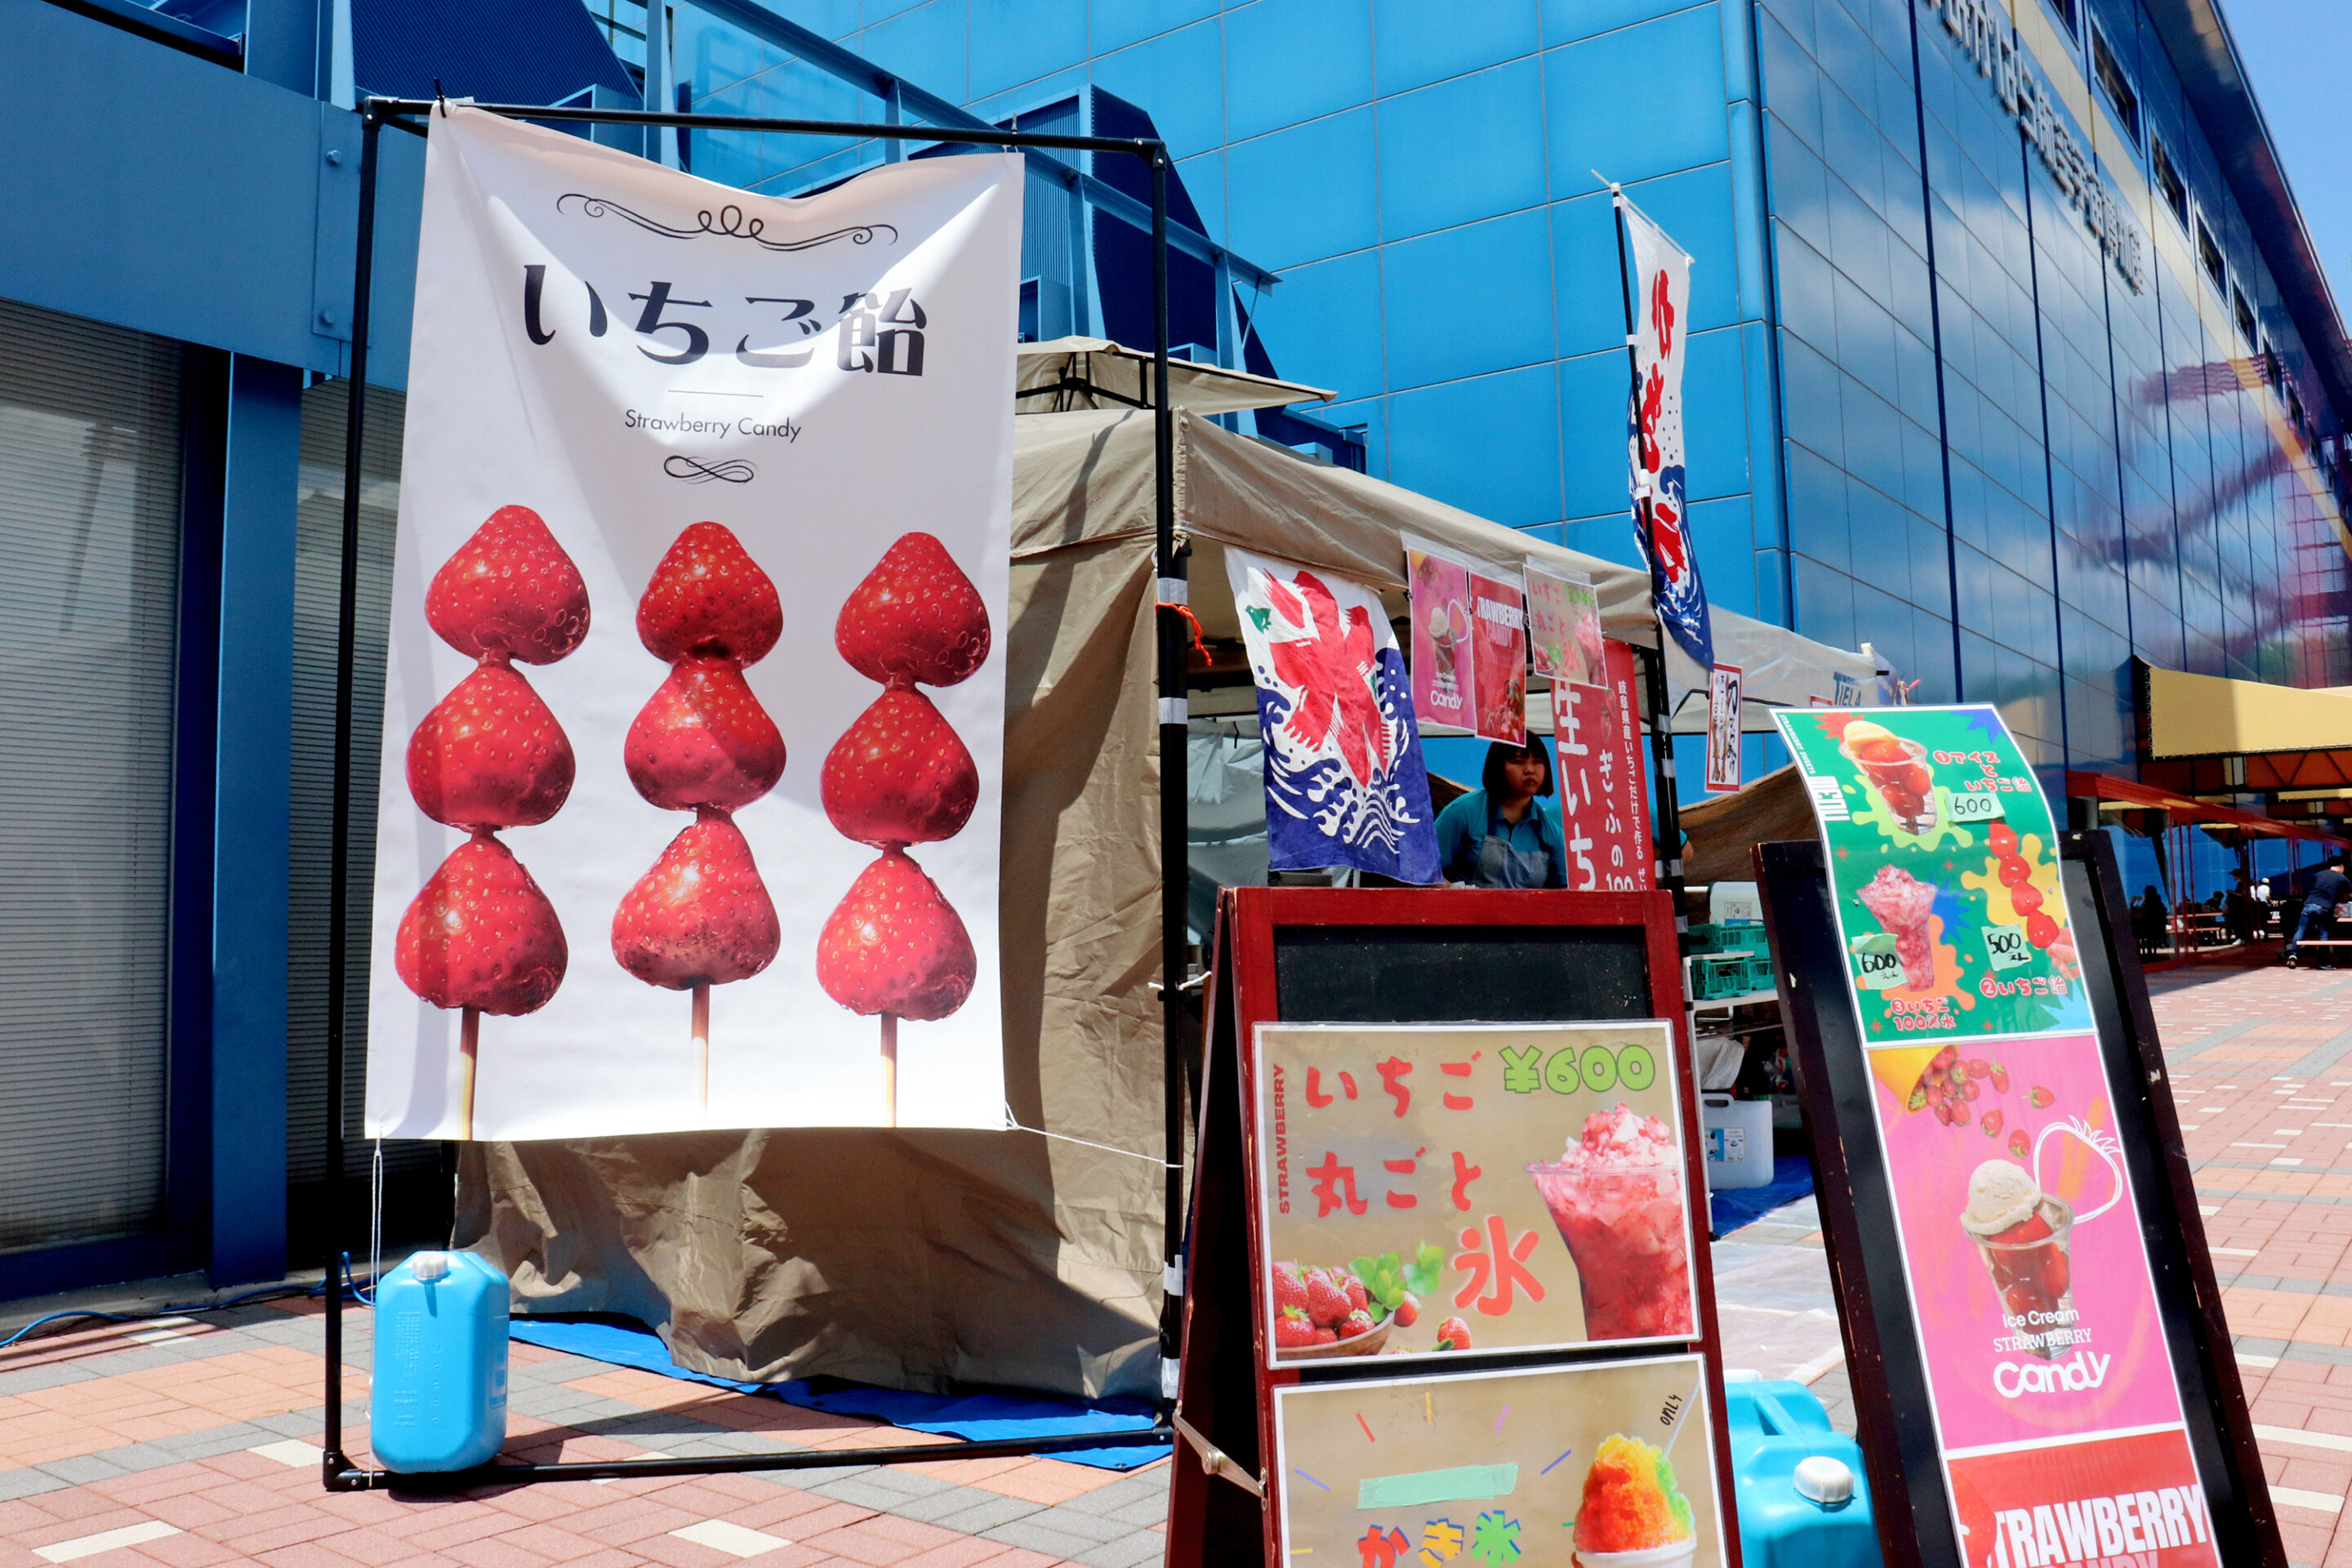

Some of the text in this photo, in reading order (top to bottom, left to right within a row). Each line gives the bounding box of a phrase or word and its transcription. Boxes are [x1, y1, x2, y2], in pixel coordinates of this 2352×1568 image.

[523, 264, 928, 377] いちご飴
[625, 409, 802, 443] Strawberry Candy
[1475, 595, 1525, 631] TRAWBERRY
[1430, 689, 1463, 710] Candy
[1980, 764, 1999, 777] と
[1954, 796, 1992, 815] 600
[1987, 933, 2021, 954] 500
[1862, 952, 1896, 973] 600
[1306, 1045, 1656, 1118] いちご ¥600
[1272, 1062, 1290, 1215] STRAWBERRY
[1306, 1146, 1482, 1218] 丸ごと
[1454, 1214, 1545, 1316] 氷
[2002, 1308, 2080, 1329] Ice Cream
[1993, 1328, 2091, 1353] STRAWBERRY
[1993, 1350, 2111, 1399] Candy
[1356, 1509, 1521, 1568] かき氷
[1960, 1483, 2207, 1568] TRAWBERRY
